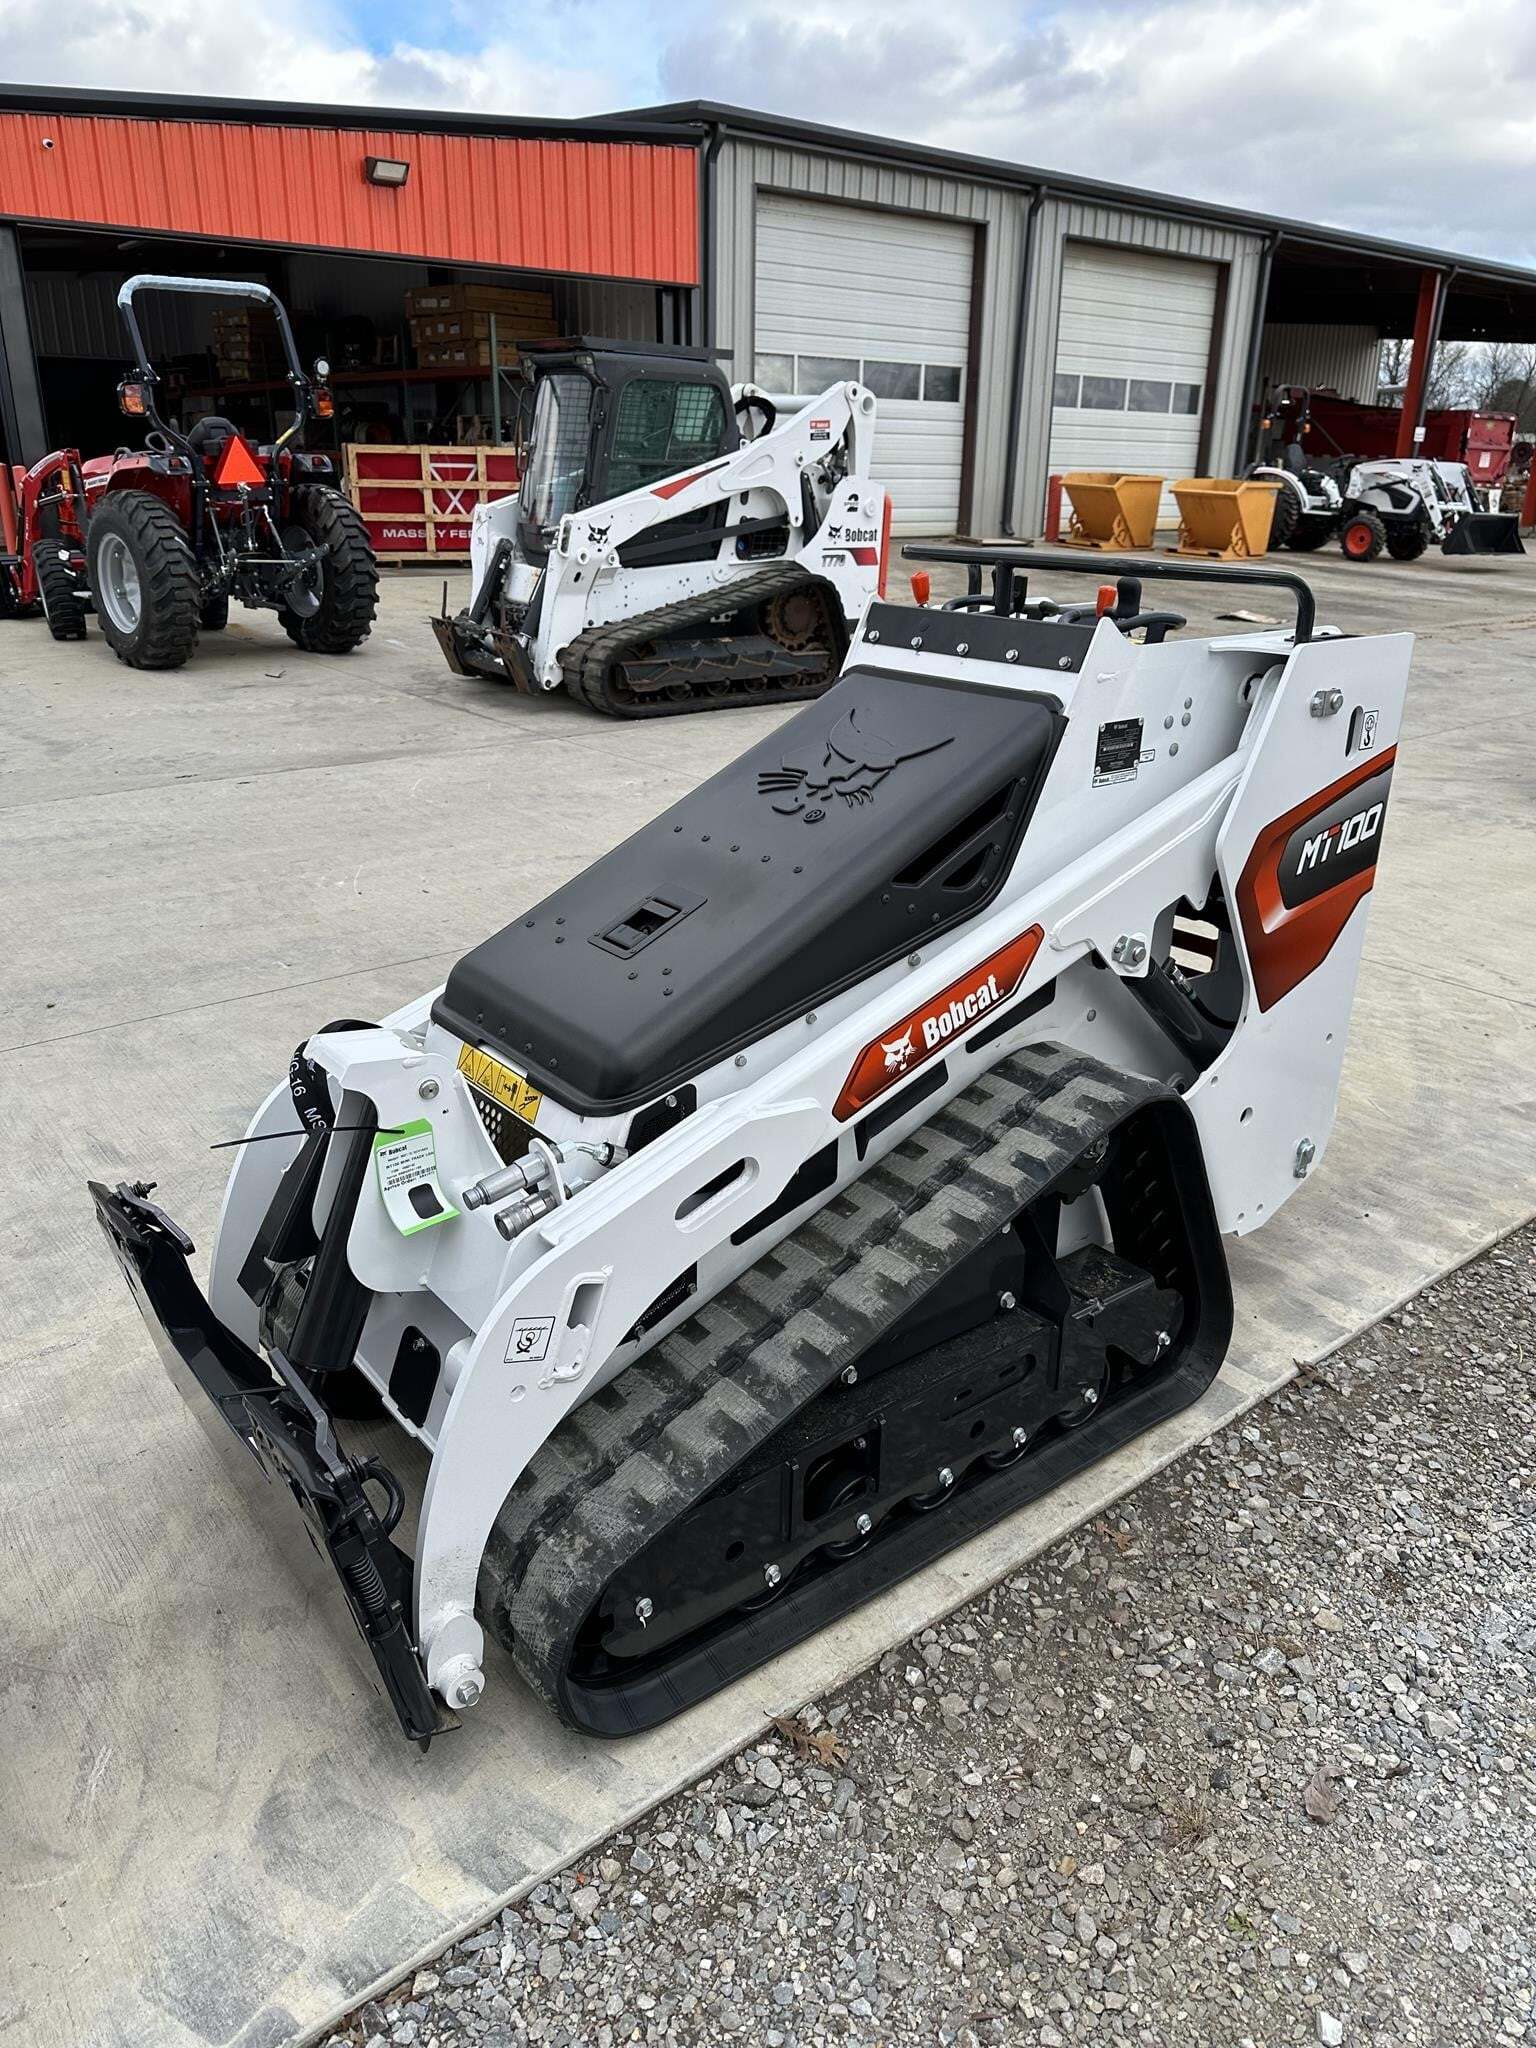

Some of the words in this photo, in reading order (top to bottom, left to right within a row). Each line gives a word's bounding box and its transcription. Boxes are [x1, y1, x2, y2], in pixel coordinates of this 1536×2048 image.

[383, 529, 446, 538] MASSY
[845, 528, 878, 542] Bobcat
[1296, 802, 1383, 876] MT100
